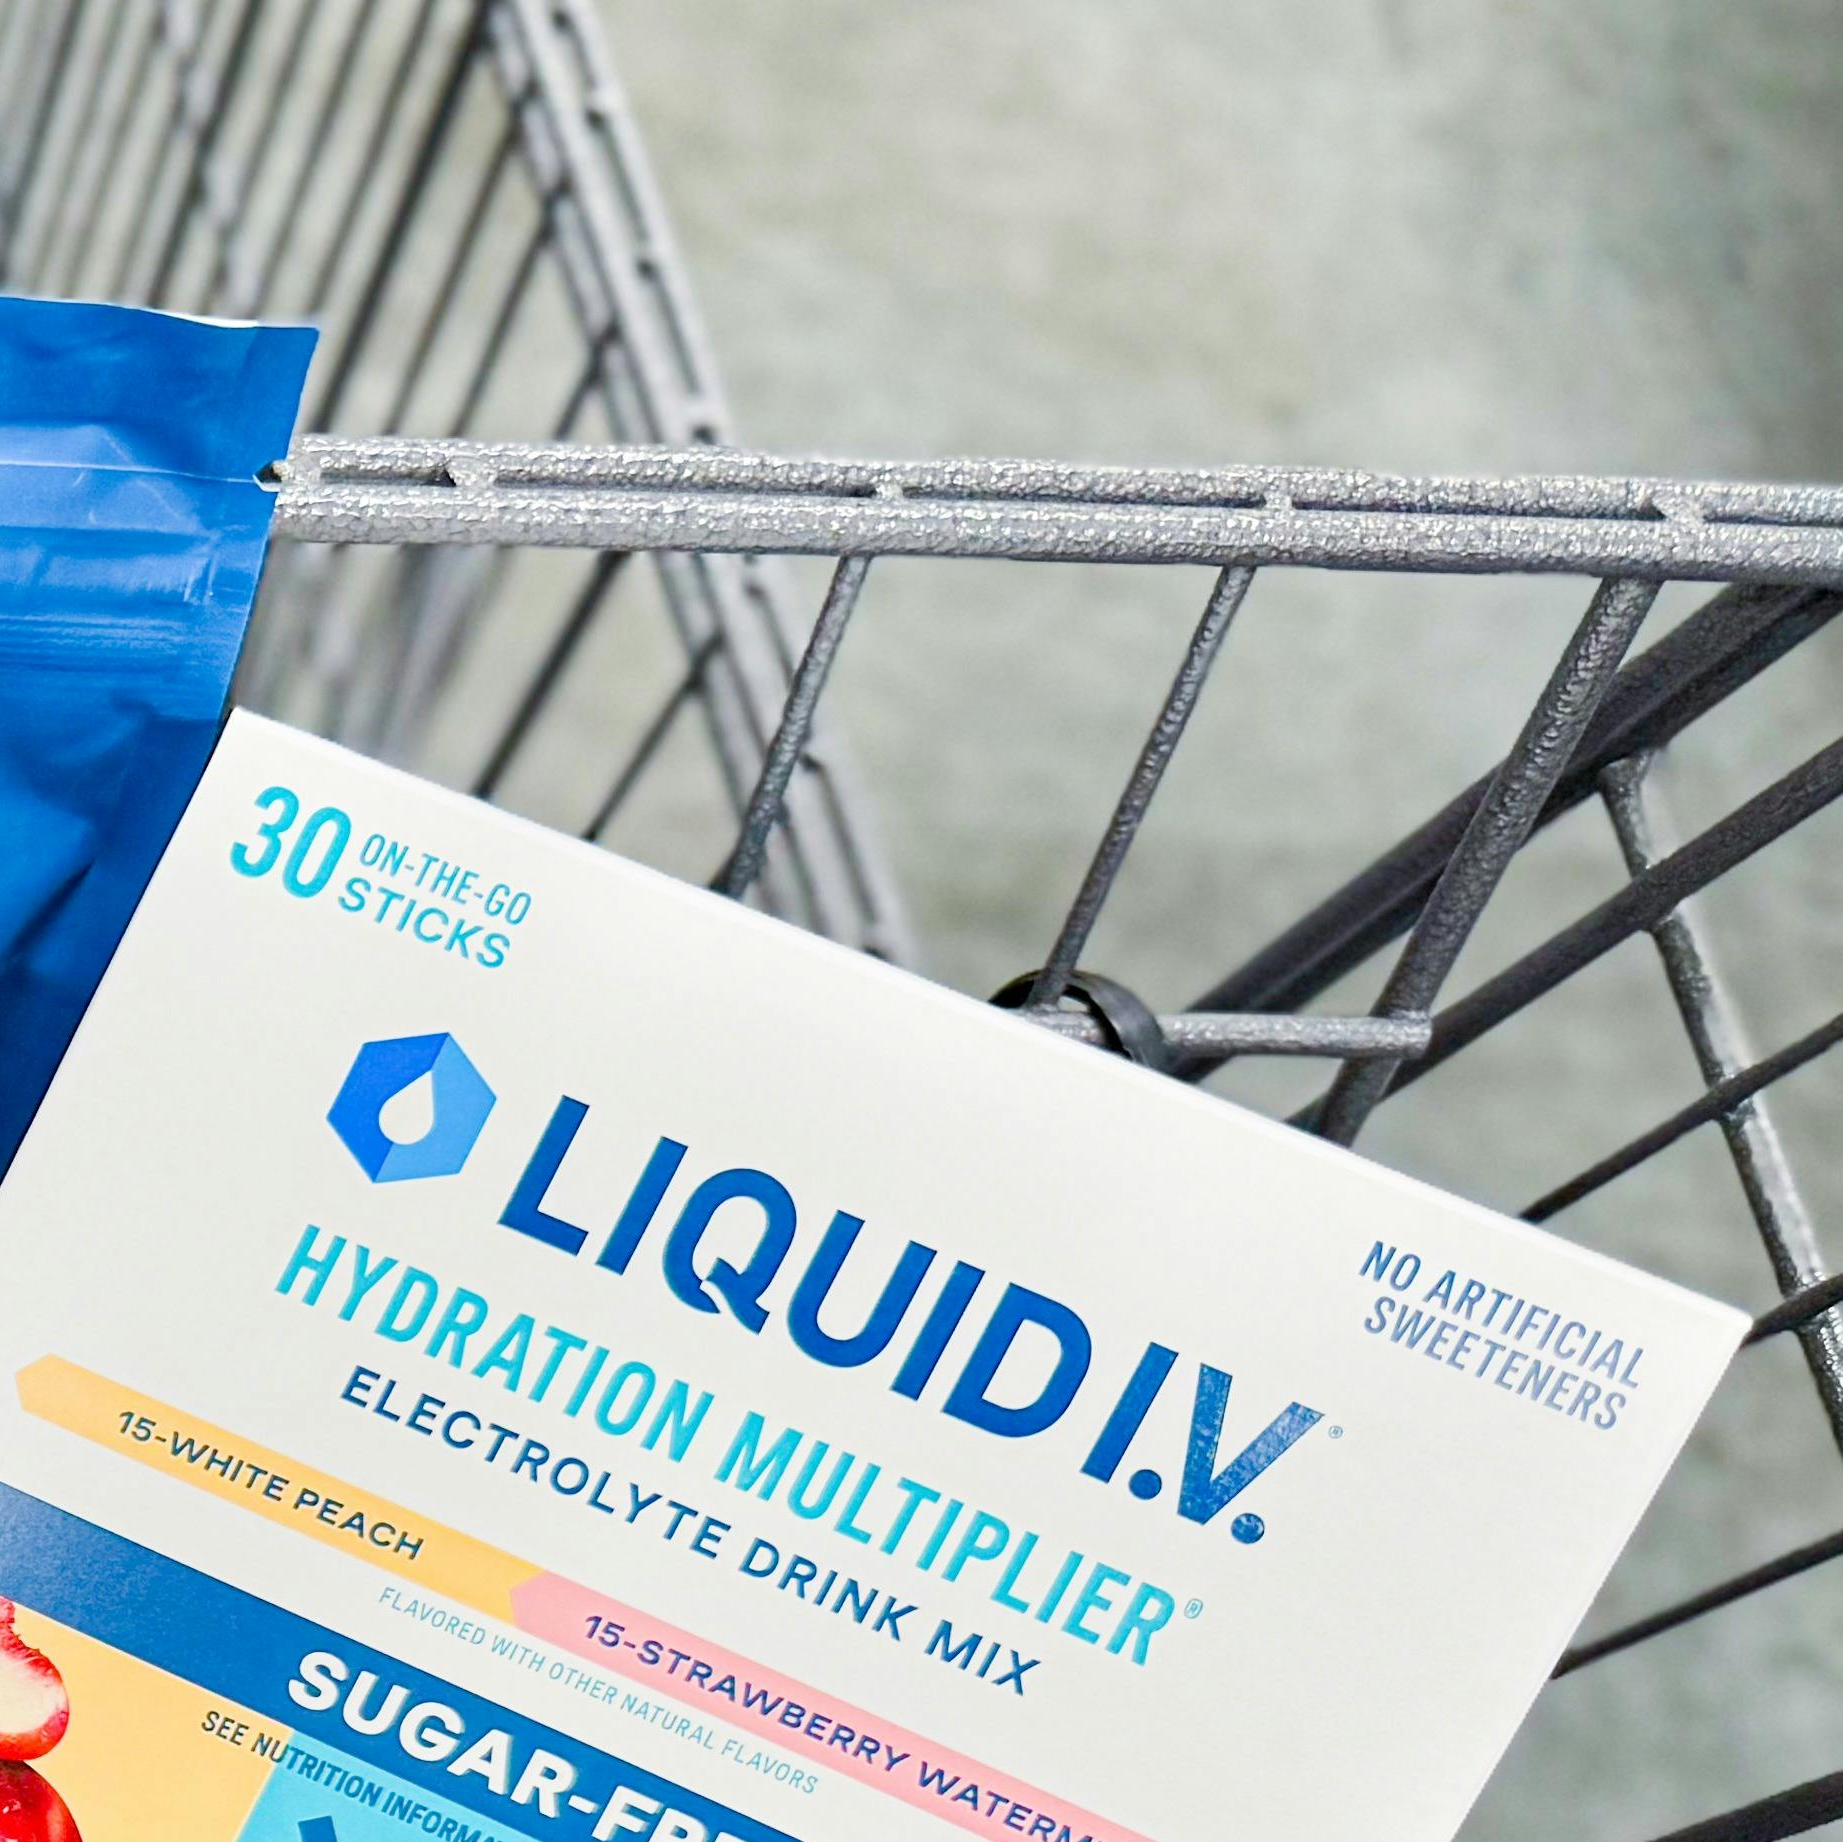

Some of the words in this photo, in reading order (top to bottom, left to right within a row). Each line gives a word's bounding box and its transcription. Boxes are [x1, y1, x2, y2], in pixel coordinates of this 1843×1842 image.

[229, 786, 352, 899] 30
[359, 833, 532, 926] ON-THE-GO
[337, 876, 511, 969] STICKS
[497, 1094, 1093, 1440] LIQUID
[1080, 1341, 1325, 1546] I.V.
[1359, 1240, 1421, 1292] NO
[1422, 1269, 1644, 1389] ARTIFICIAL
[1363, 1295, 1627, 1431] SWEETENERS
[118, 1410, 291, 1504] 15-WHITE
[291, 1488, 425, 1562] PEACH
[274, 1223, 715, 1464] HYDRATION
[713, 1410, 1177, 1667] MULTIPLIER
[340, 1364, 732, 1560] ELECTROLYTE
[737, 1537, 919, 1641] DRINK
[924, 1618, 1042, 1697] MIX
[200, 1710, 250, 1748] SEE
[251, 1732, 383, 1805] NUTRITION
[379, 1586, 486, 1648] FLAVORED
[491, 1634, 546, 1673] WITH
[548, 1661, 616, 1705] OTHER
[618, 1693, 717, 1753] NATURAL
[720, 1739, 819, 1795] FLAVORS
[583, 1614, 911, 1773] 15-STRAWBERRY
